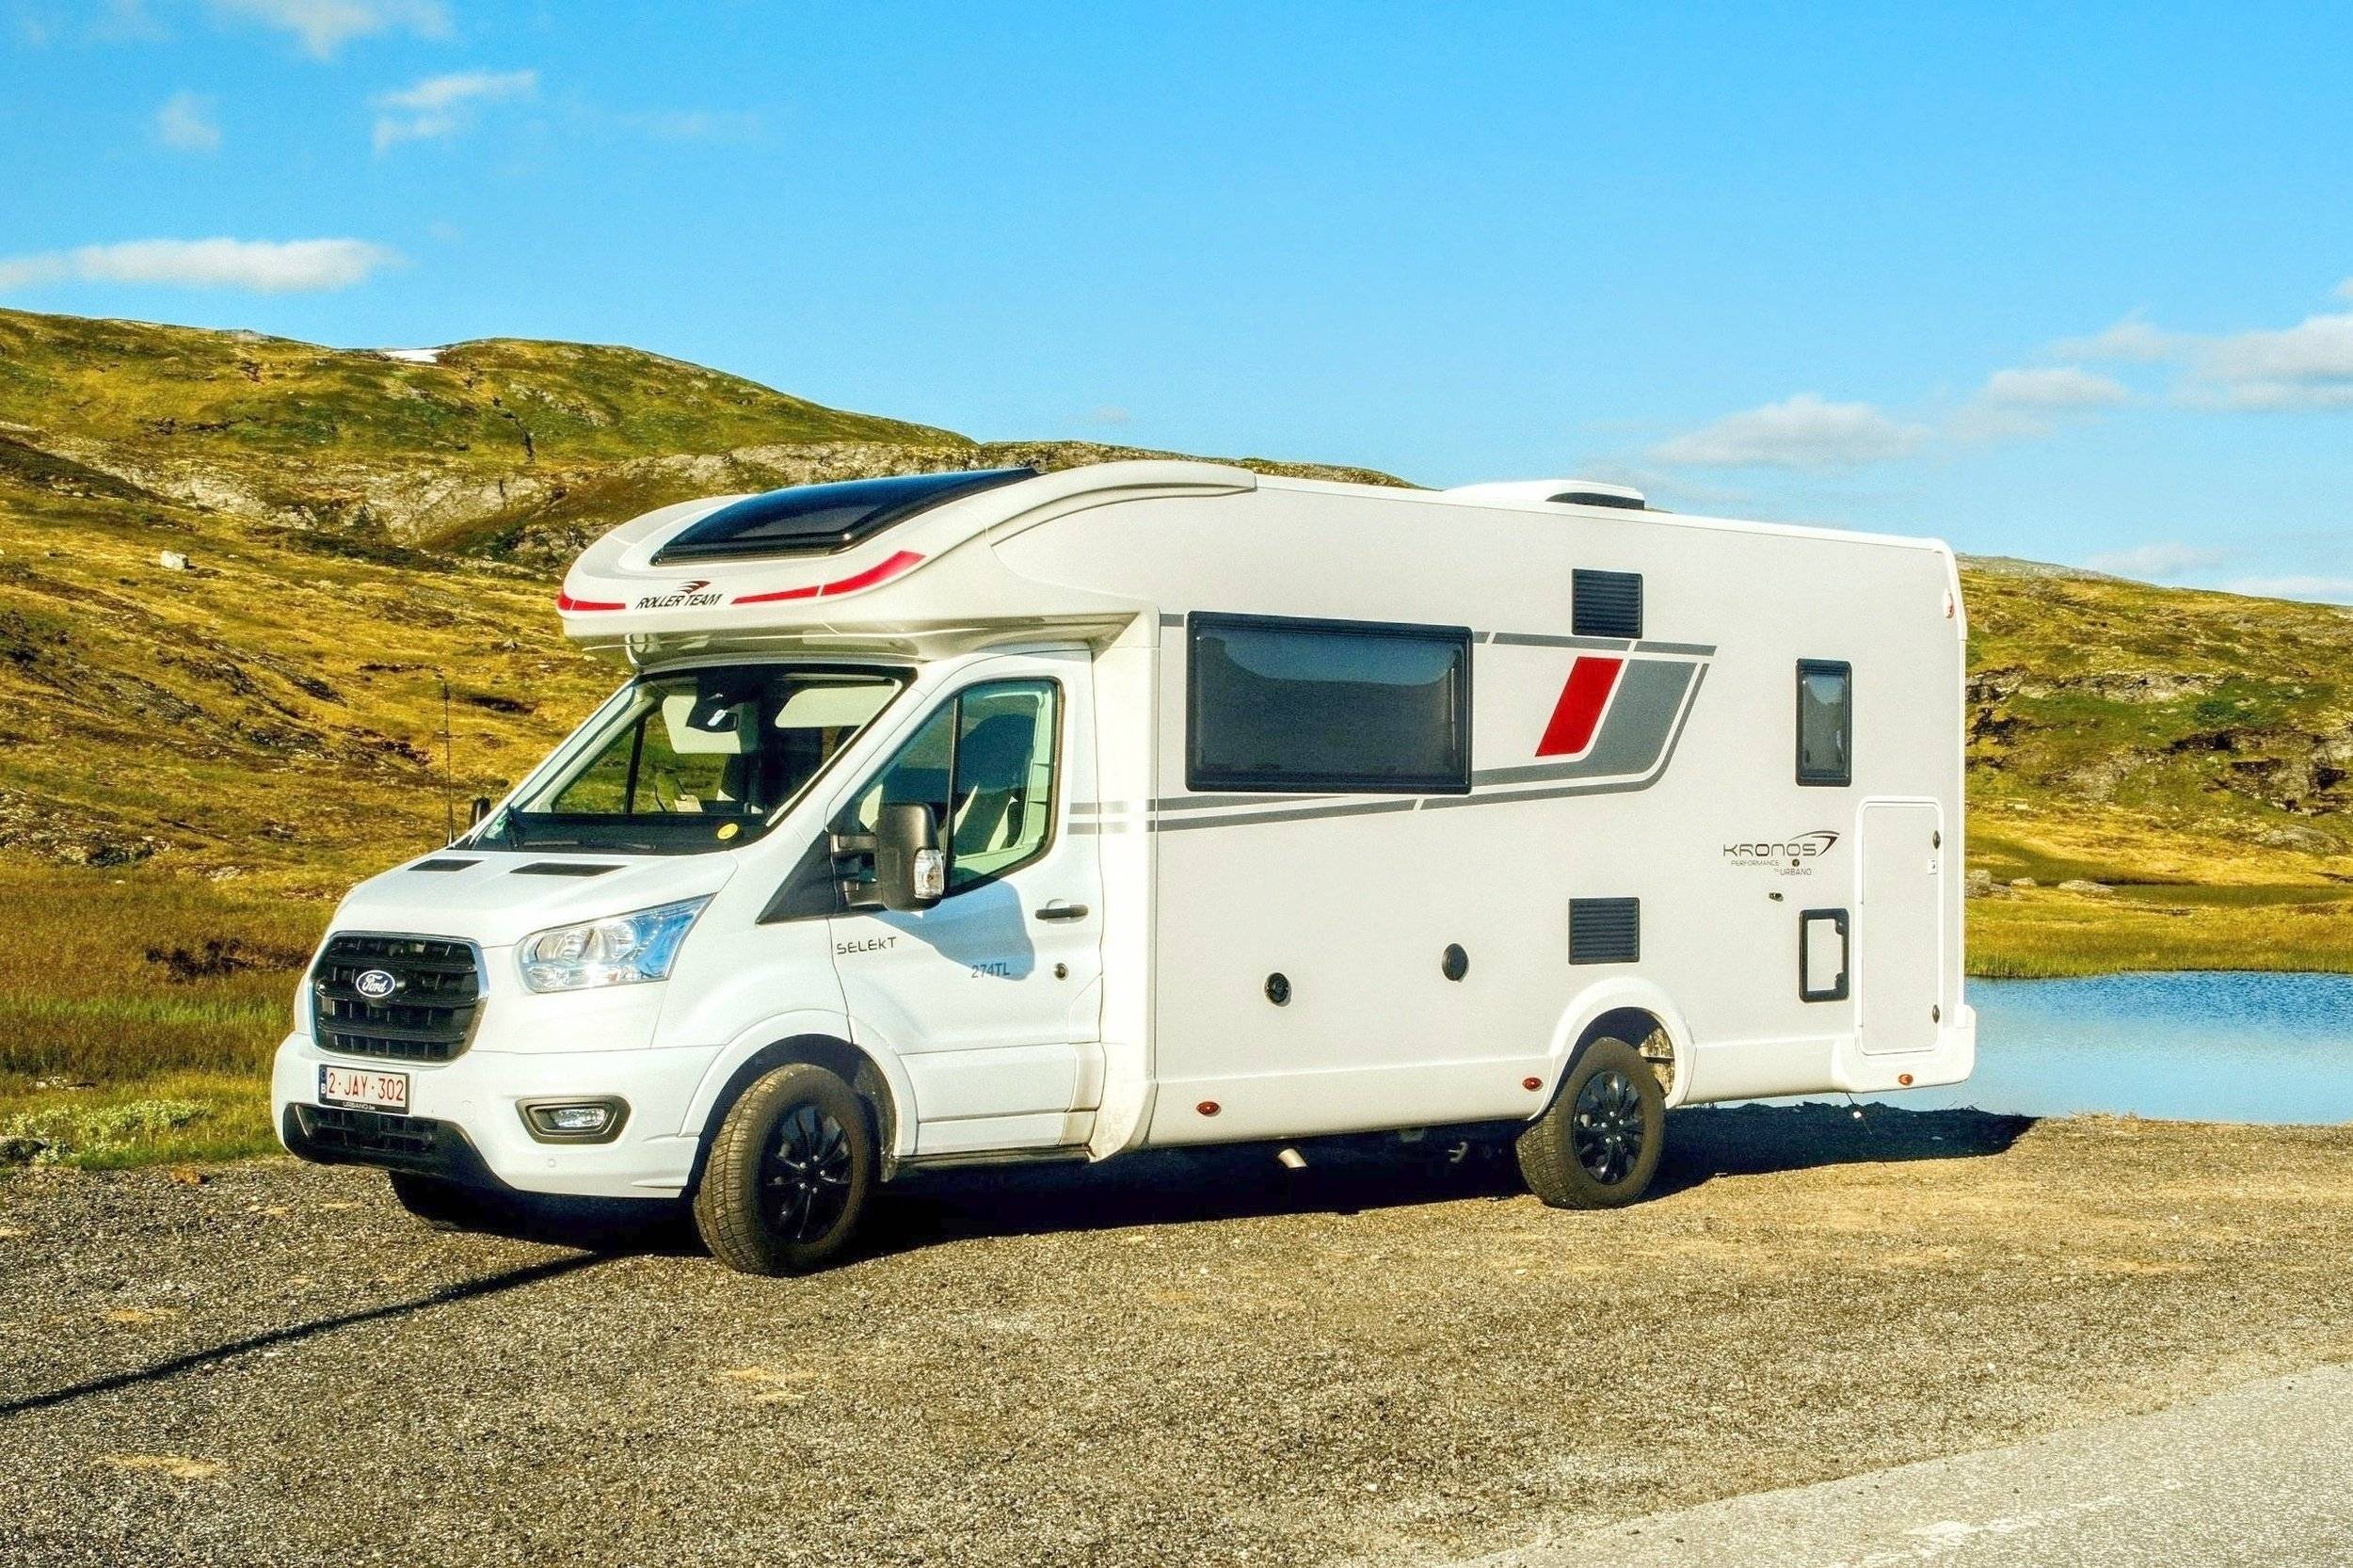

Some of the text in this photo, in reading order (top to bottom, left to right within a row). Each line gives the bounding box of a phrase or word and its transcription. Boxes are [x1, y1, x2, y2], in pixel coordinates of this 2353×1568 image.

[635, 594, 723, 609] ROLLER TEAM
[1723, 843, 1817, 856] KRONOS
[971, 962, 1010, 979] 274TL
[361, 973, 389, 993] Ford
